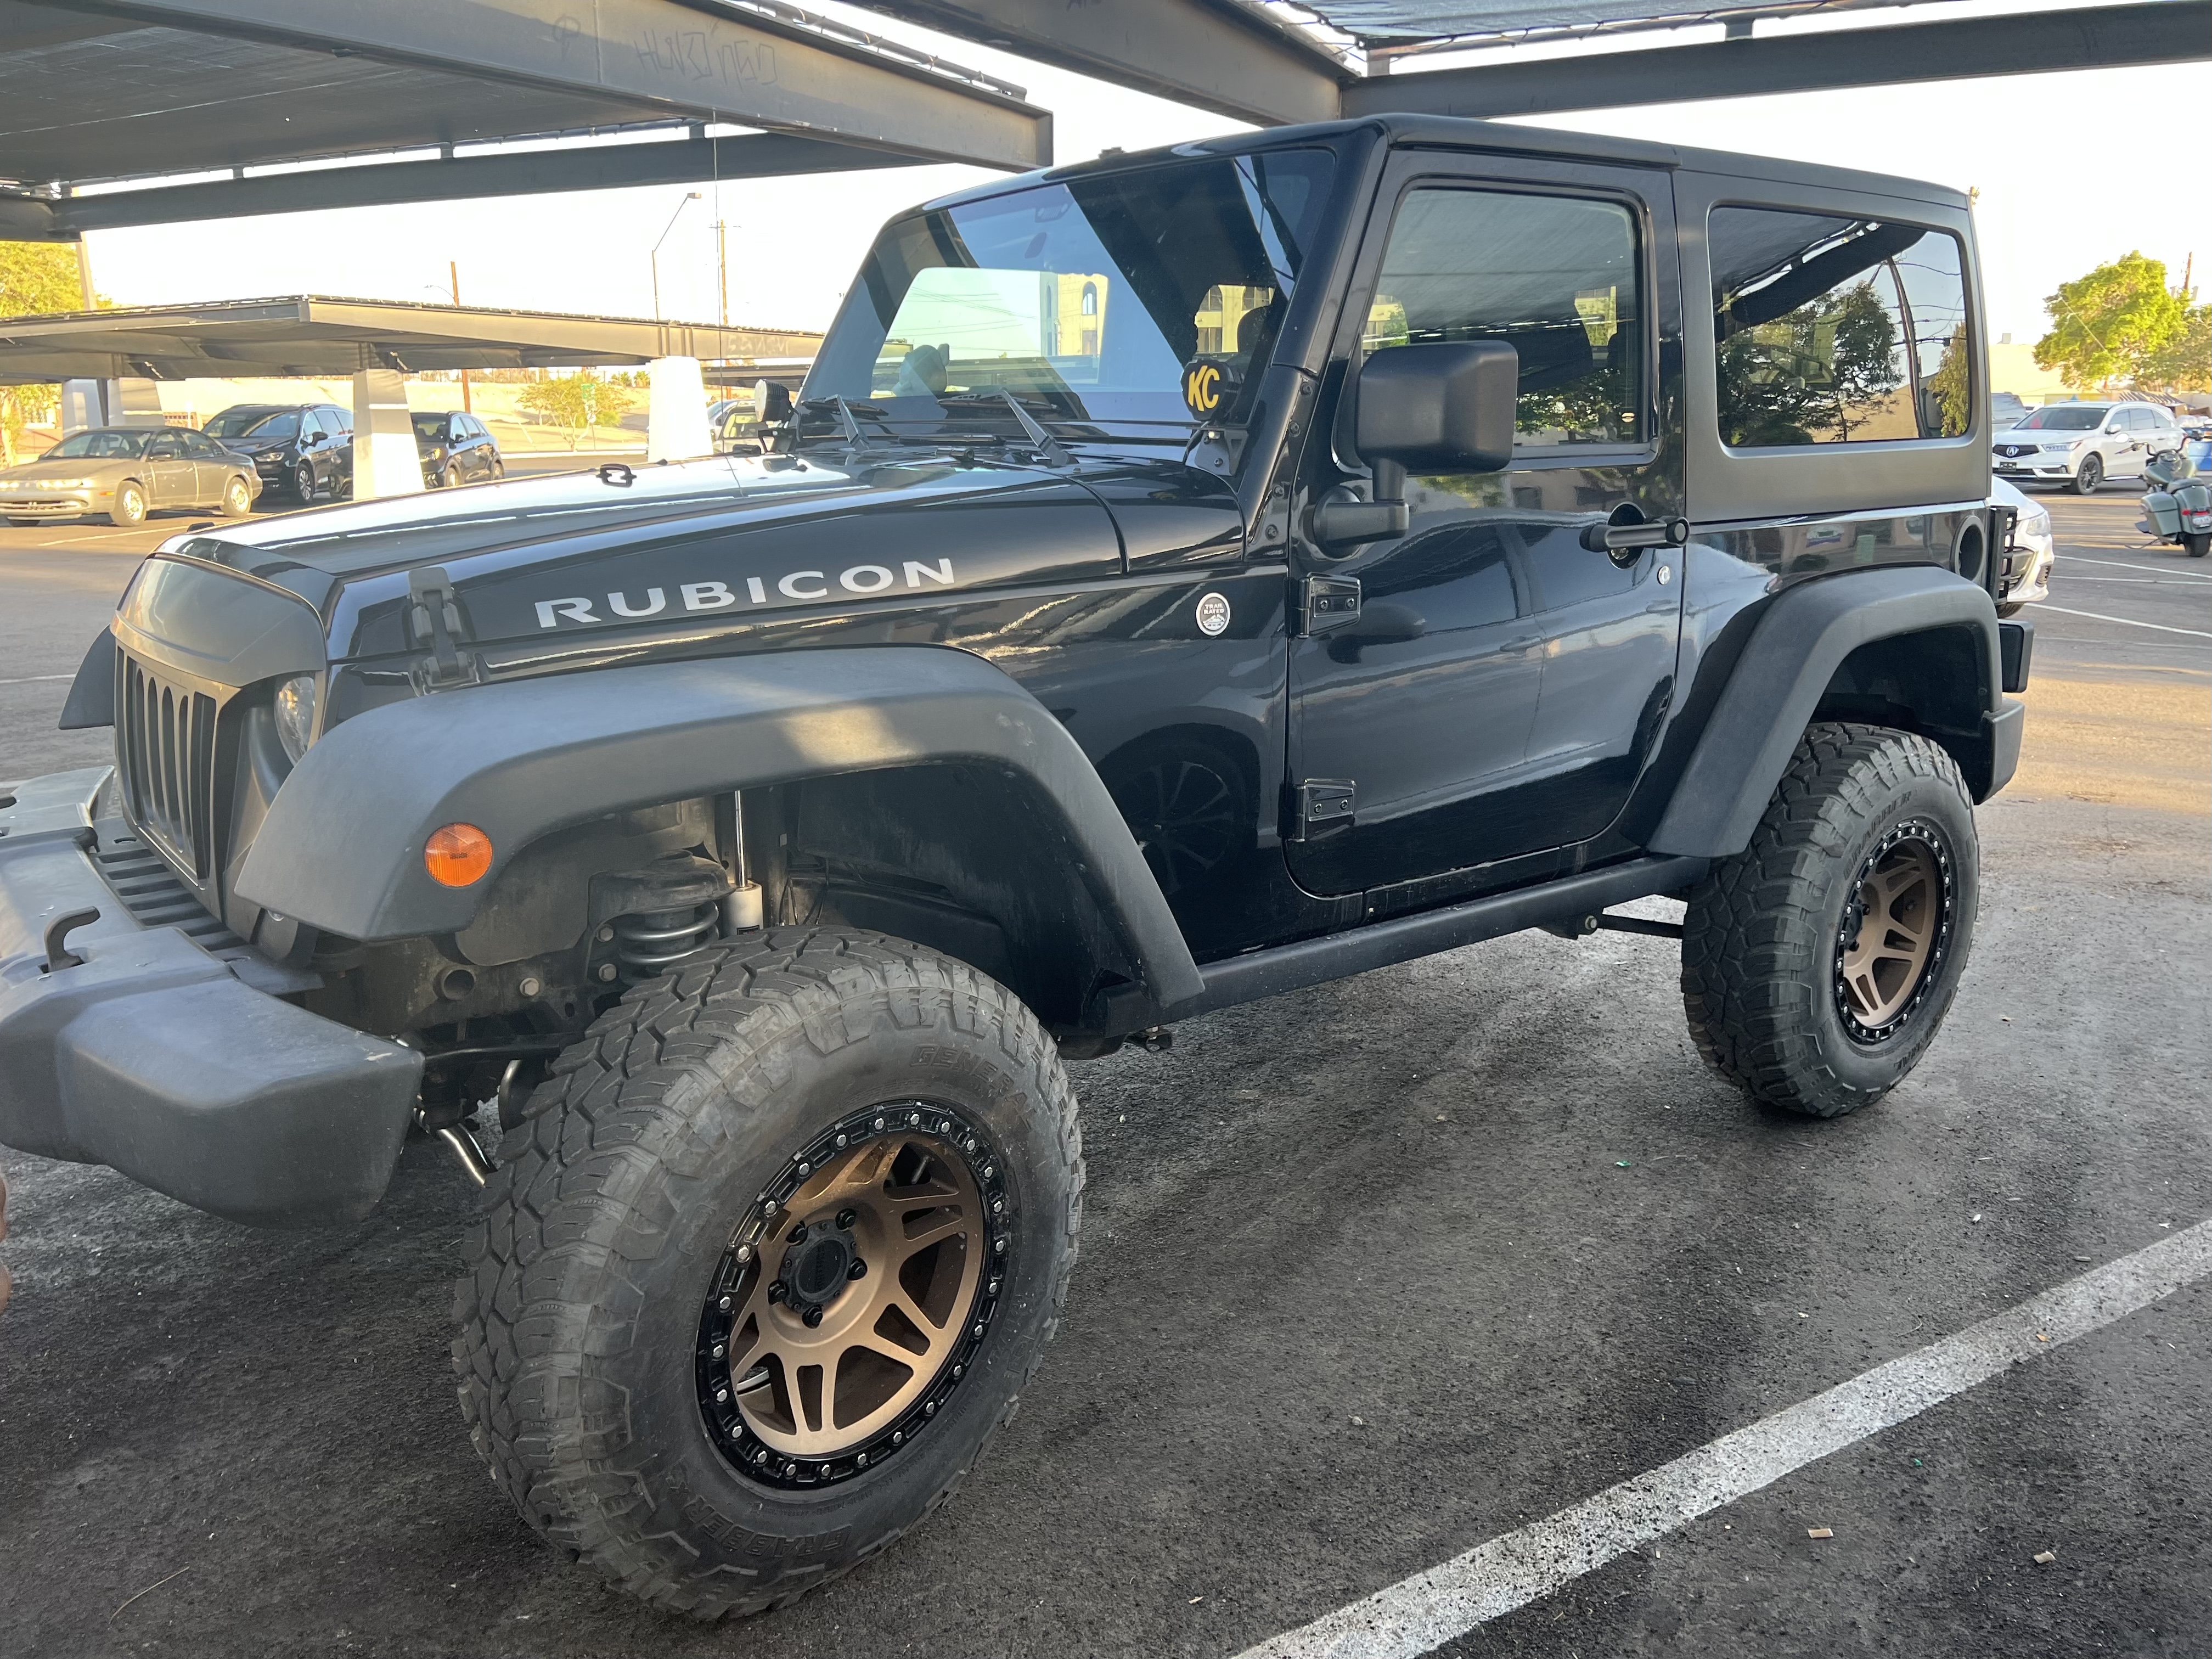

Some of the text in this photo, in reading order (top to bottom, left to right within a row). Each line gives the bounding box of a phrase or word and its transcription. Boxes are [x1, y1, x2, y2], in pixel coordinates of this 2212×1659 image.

[1188, 365, 1220, 412] KC
[534, 558, 955, 628] RUBICON
[910, 1044, 1039, 1133] GENERAL
[683, 1493, 852, 1560] GRABBER
